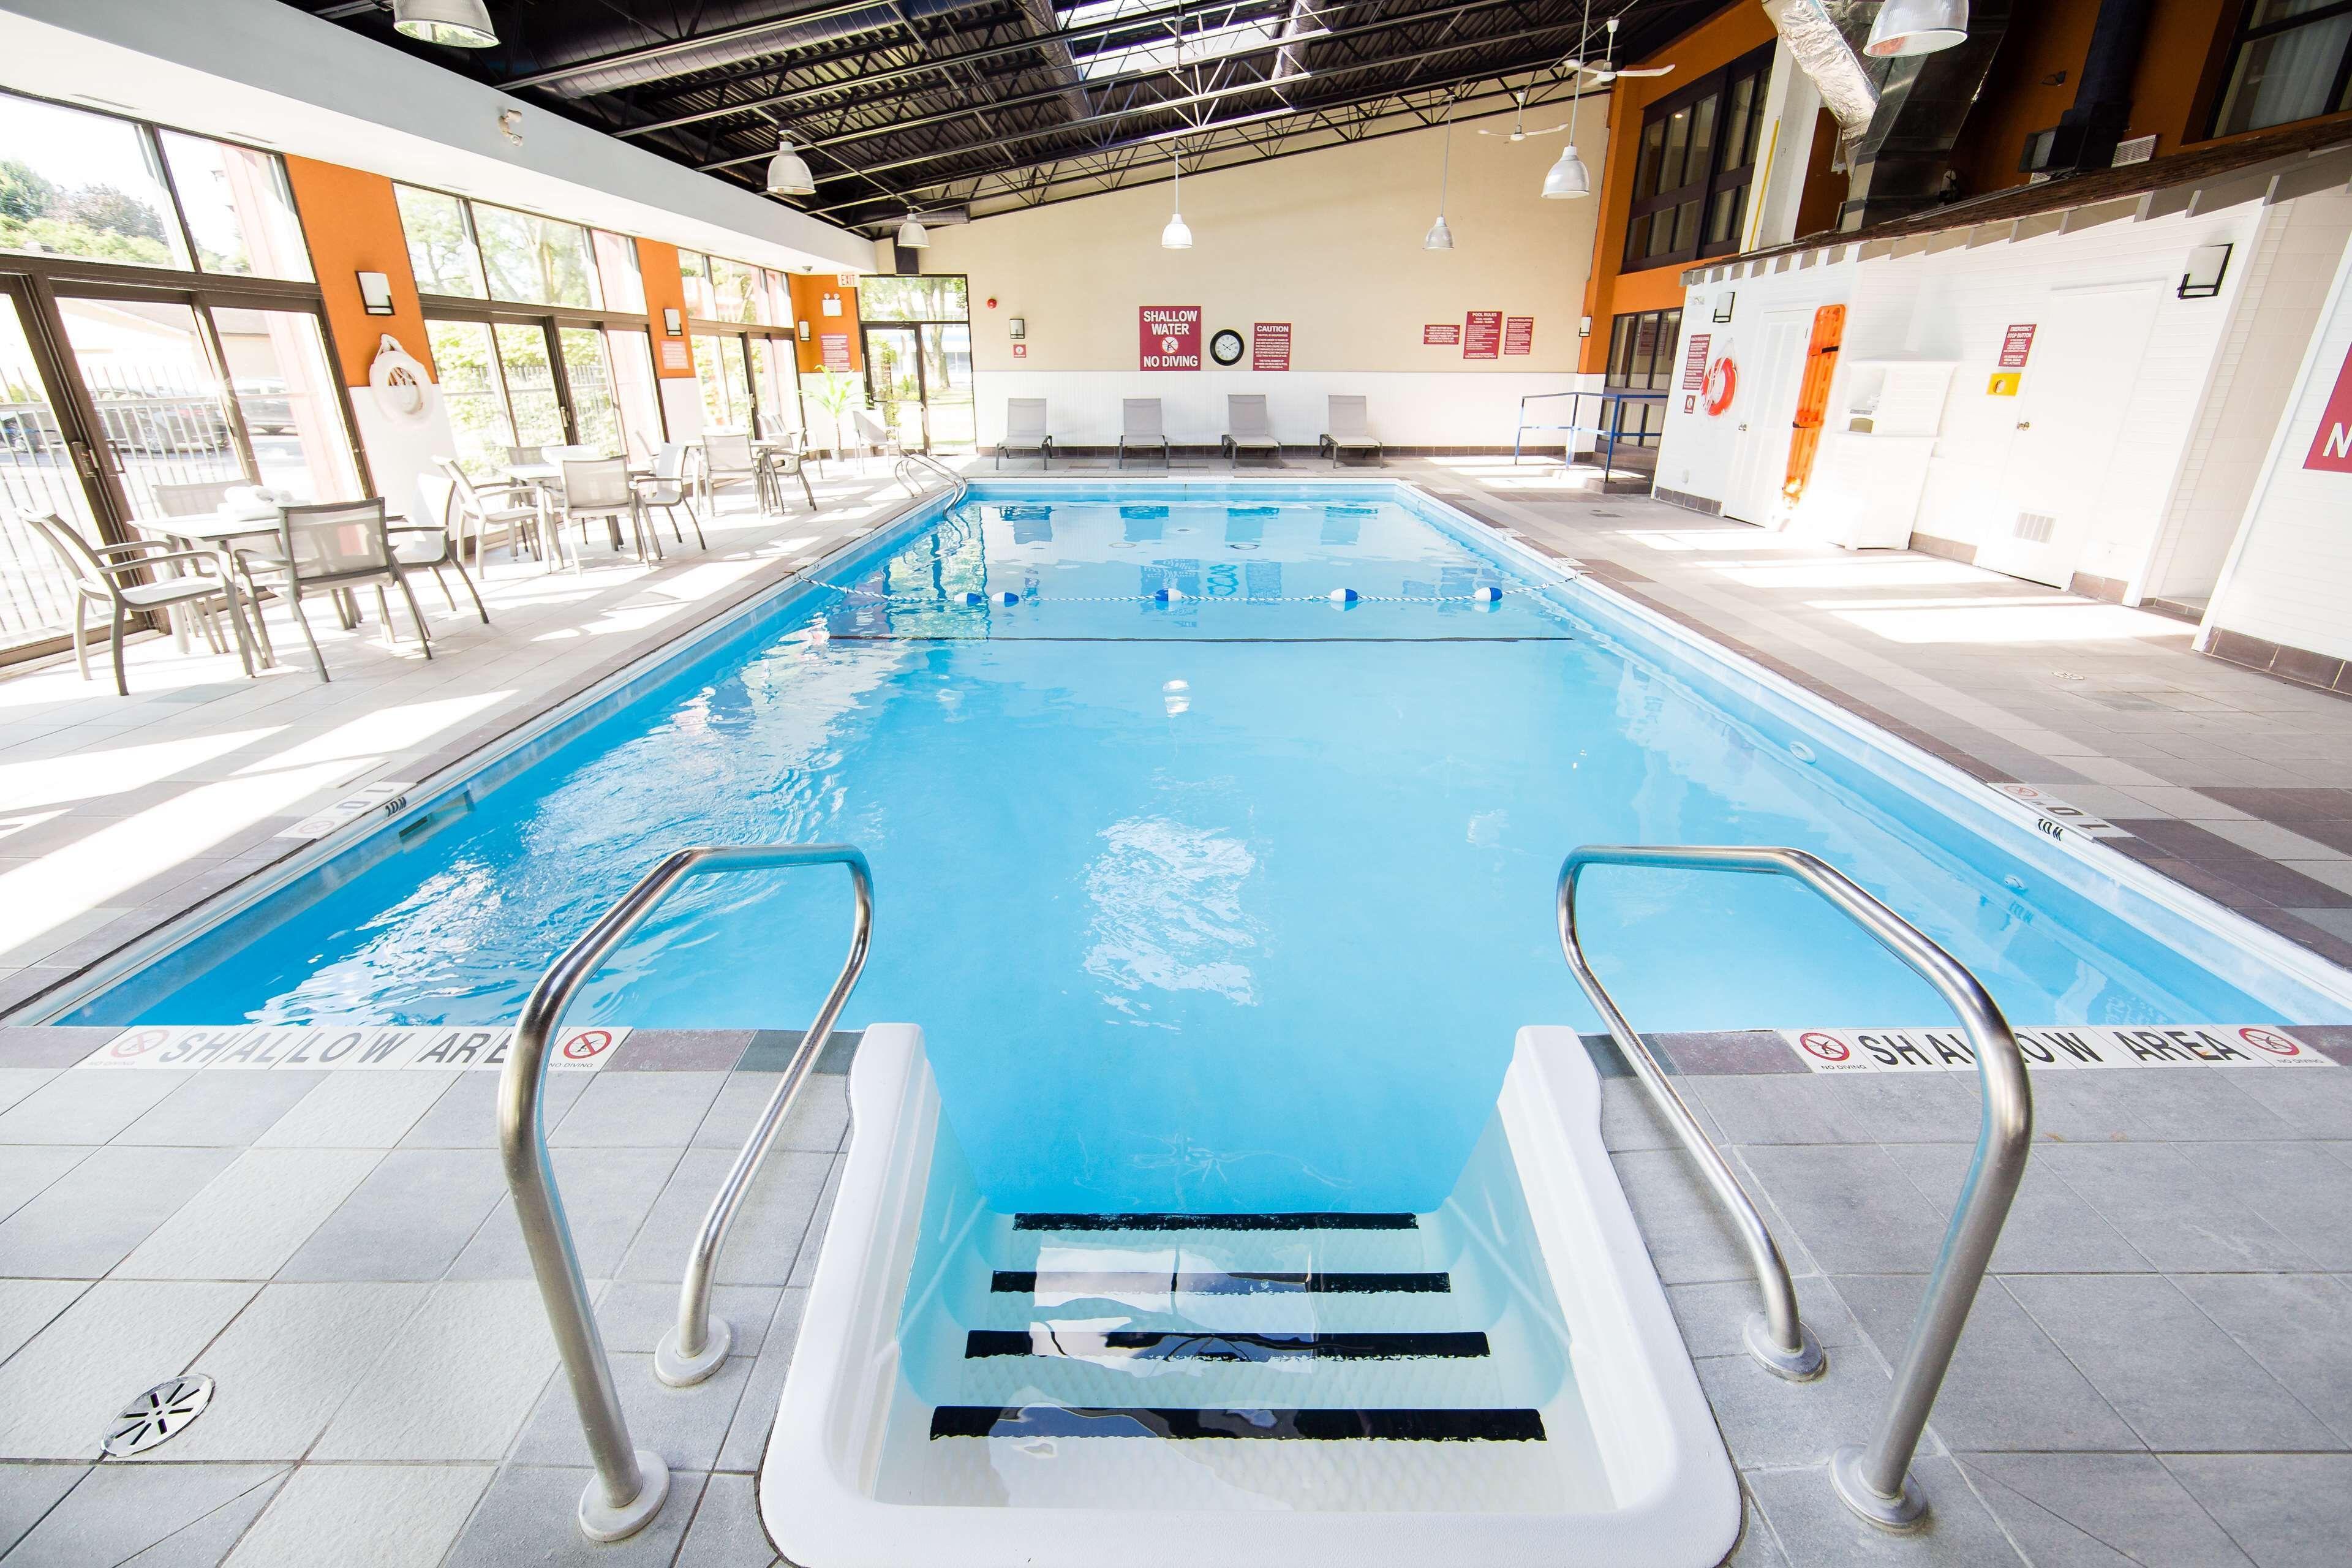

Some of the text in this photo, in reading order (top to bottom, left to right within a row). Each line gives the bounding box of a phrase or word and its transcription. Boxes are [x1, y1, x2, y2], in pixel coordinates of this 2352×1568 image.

[841, 274, 855, 285] EXIT
[1144, 311, 1197, 322] SHALLOW
[1152, 323, 1189, 335] WATER
[1144, 355, 1198, 367] NO DIVING
[159, 1033, 512, 1063] SHALLOW ARE
[1858, 1031, 2252, 1065] SHALOW AREA
